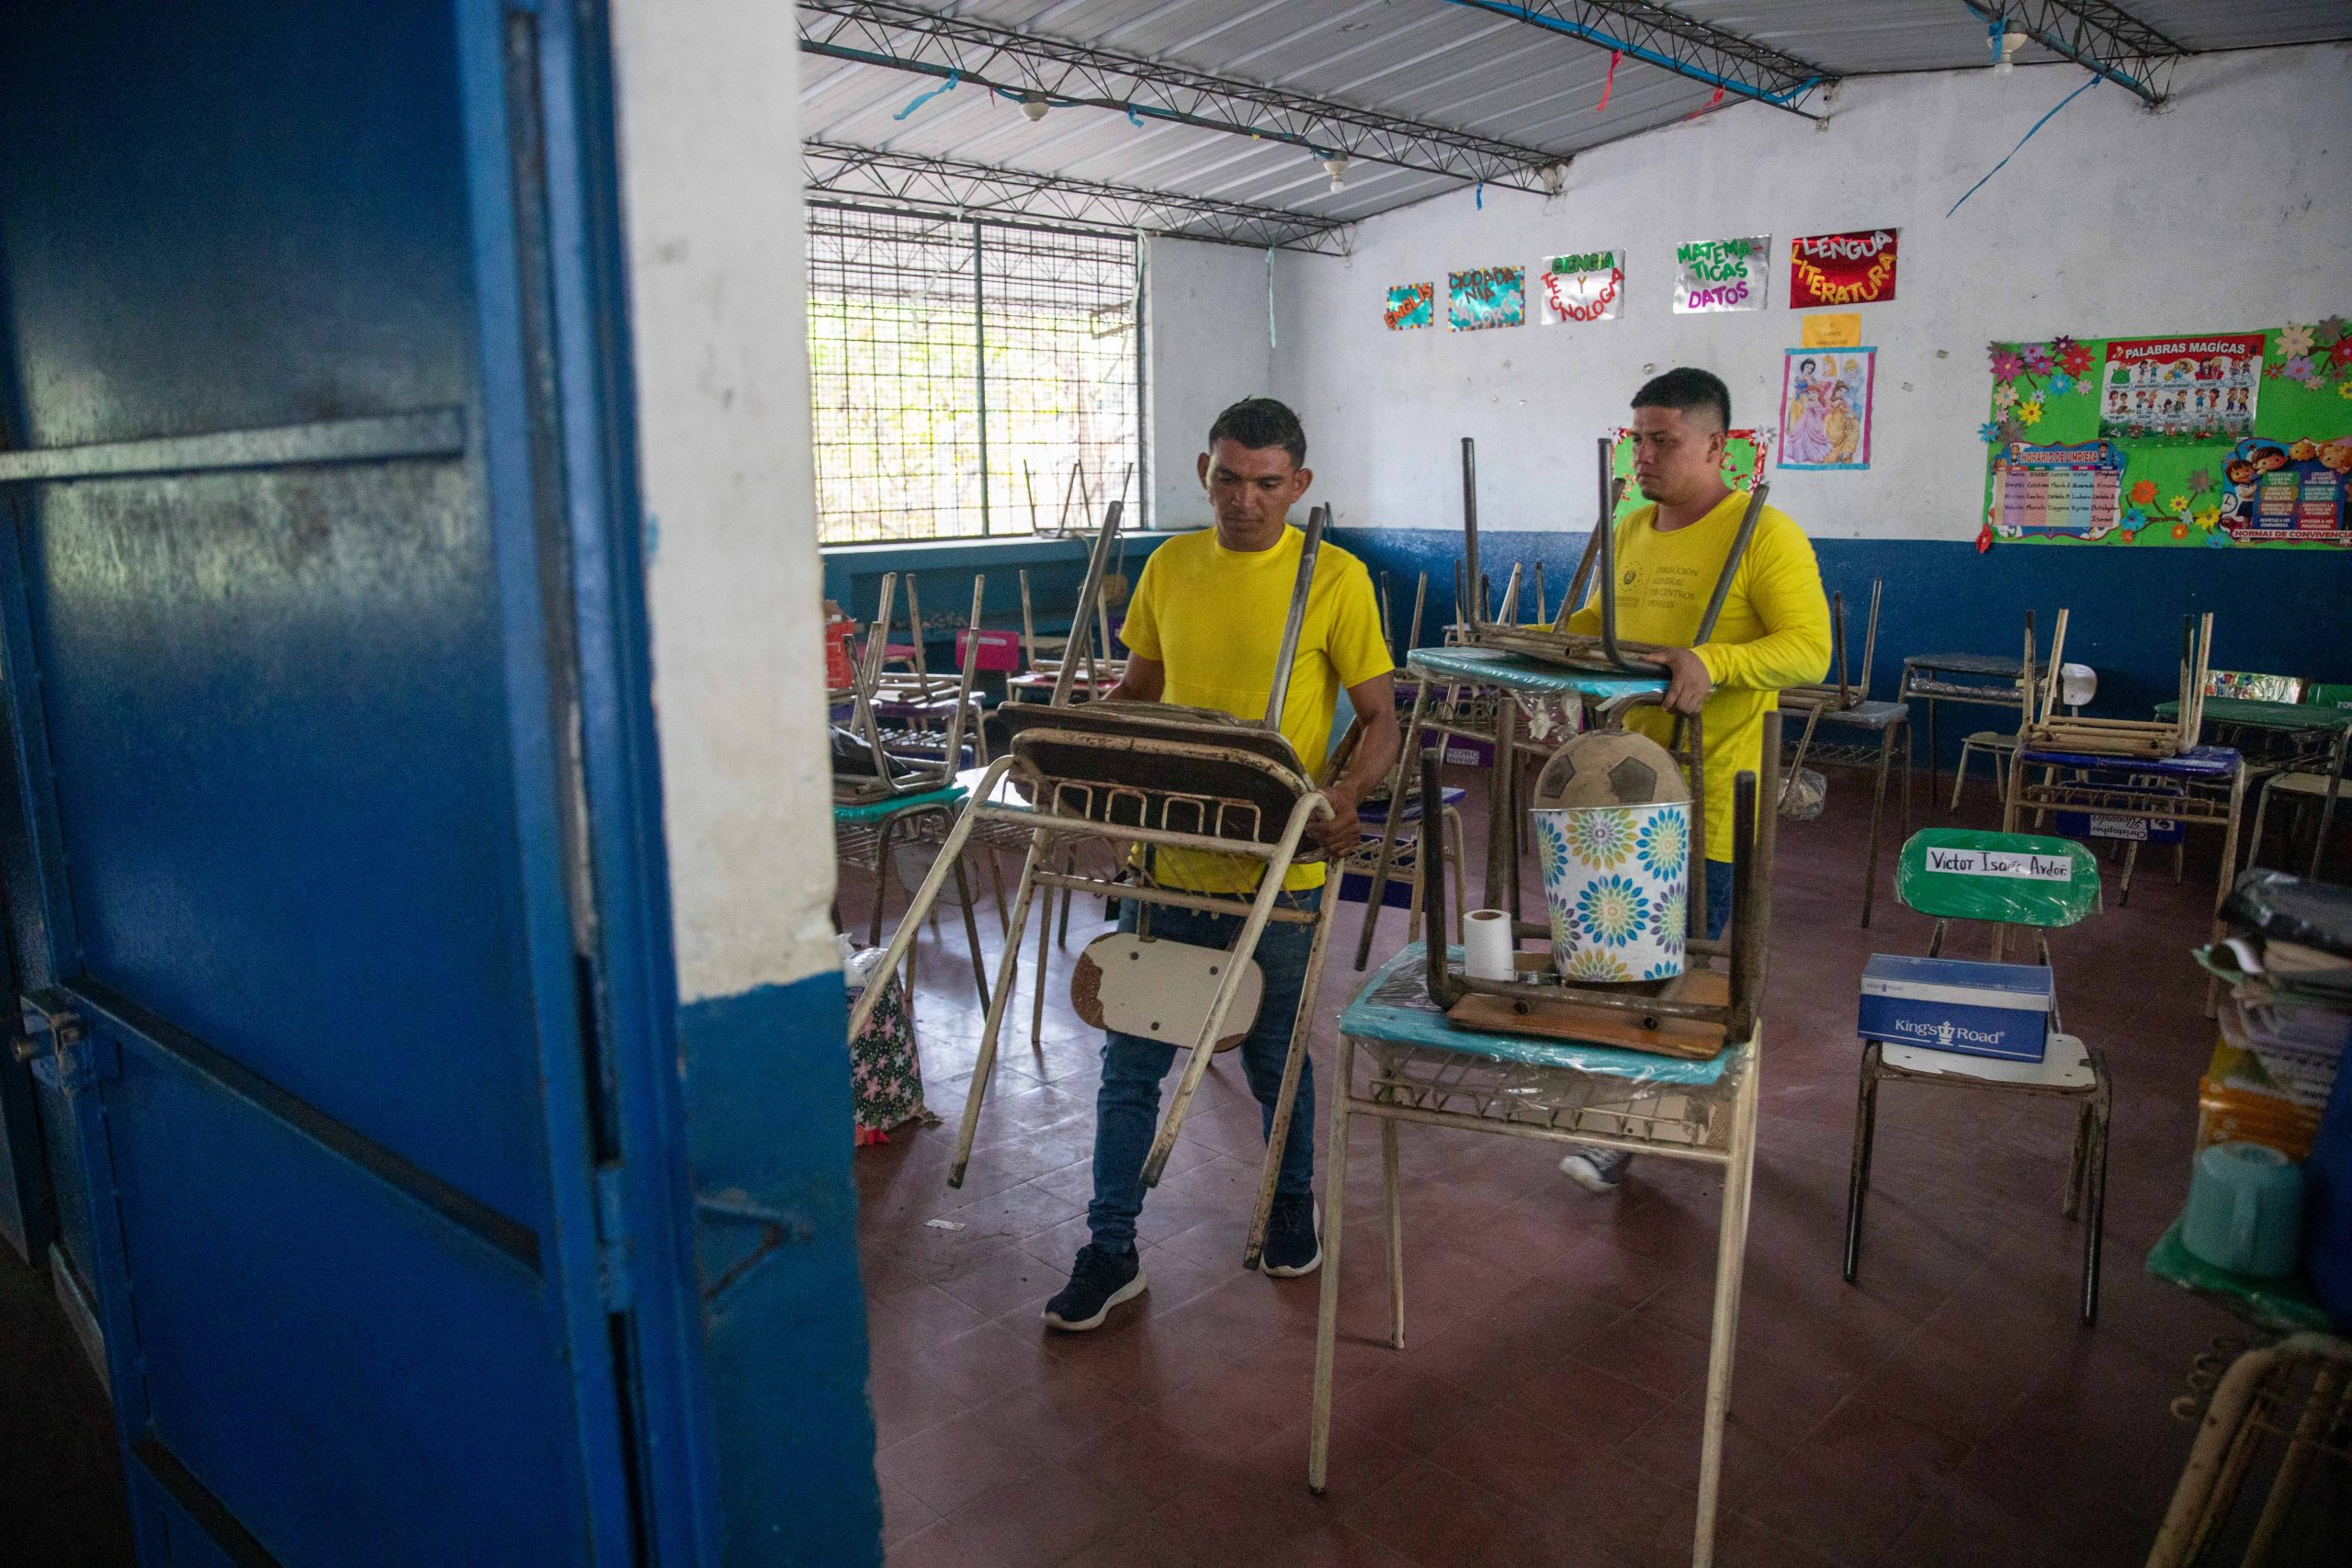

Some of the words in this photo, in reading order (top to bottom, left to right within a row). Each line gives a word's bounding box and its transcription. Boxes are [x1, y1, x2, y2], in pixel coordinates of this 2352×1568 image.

[1803, 231, 1893, 260] LENGUA
[1552, 252, 1614, 275] CIENCIA
[1690, 261, 1748, 281] TICAS
[1792, 244, 1897, 304] LITERATURA
[1541, 267, 1625, 321] TECNOLOGIA
[1577, 276, 1587, 294] Y
[1688, 281, 1749, 309] DATOS
[2125, 344, 2186, 358] PALABRAS
[2022, 451, 2054, 462] HORARIO
[2055, 451, 2064, 462] DE
[2065, 451, 2098, 462] LIMPIEZA
[2275, 530, 2288, 538] DE
[2092, 826, 2146, 839] Christopher
[1930, 852, 1974, 871] Victor
[1895, 1019, 1939, 1037] King's
